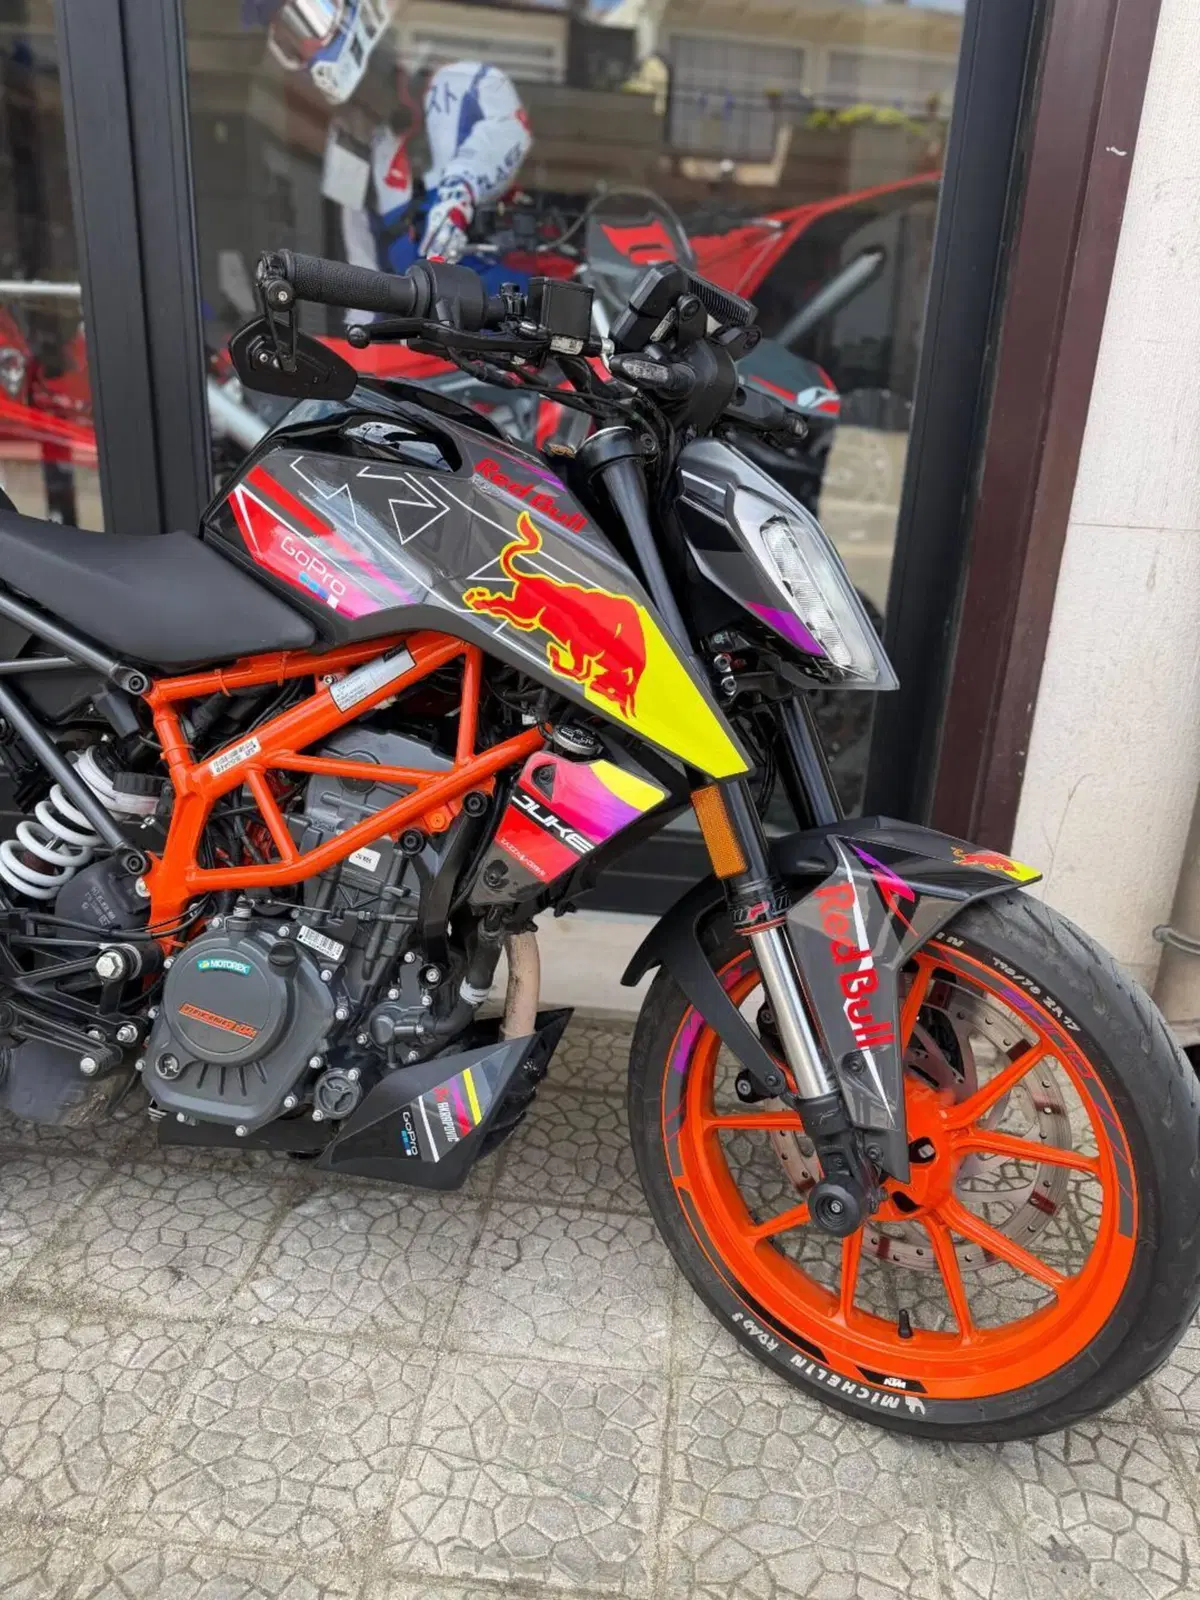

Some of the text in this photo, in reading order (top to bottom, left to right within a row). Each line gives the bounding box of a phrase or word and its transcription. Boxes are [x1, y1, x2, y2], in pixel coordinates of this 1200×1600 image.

[474, 458, 588, 534] Red Bull
[280, 536, 346, 596] GoPro
[511, 794, 596, 854] DUKE
[210, 959, 249, 975] MOTOREX
[814, 881, 896, 1049] Red Bull
[402, 1111, 419, 1156] GoPro
[742, 1319, 779, 1352] ROAD
[790, 1354, 900, 1409] MICHELIN
[883, 1377, 907, 1390] KTM
